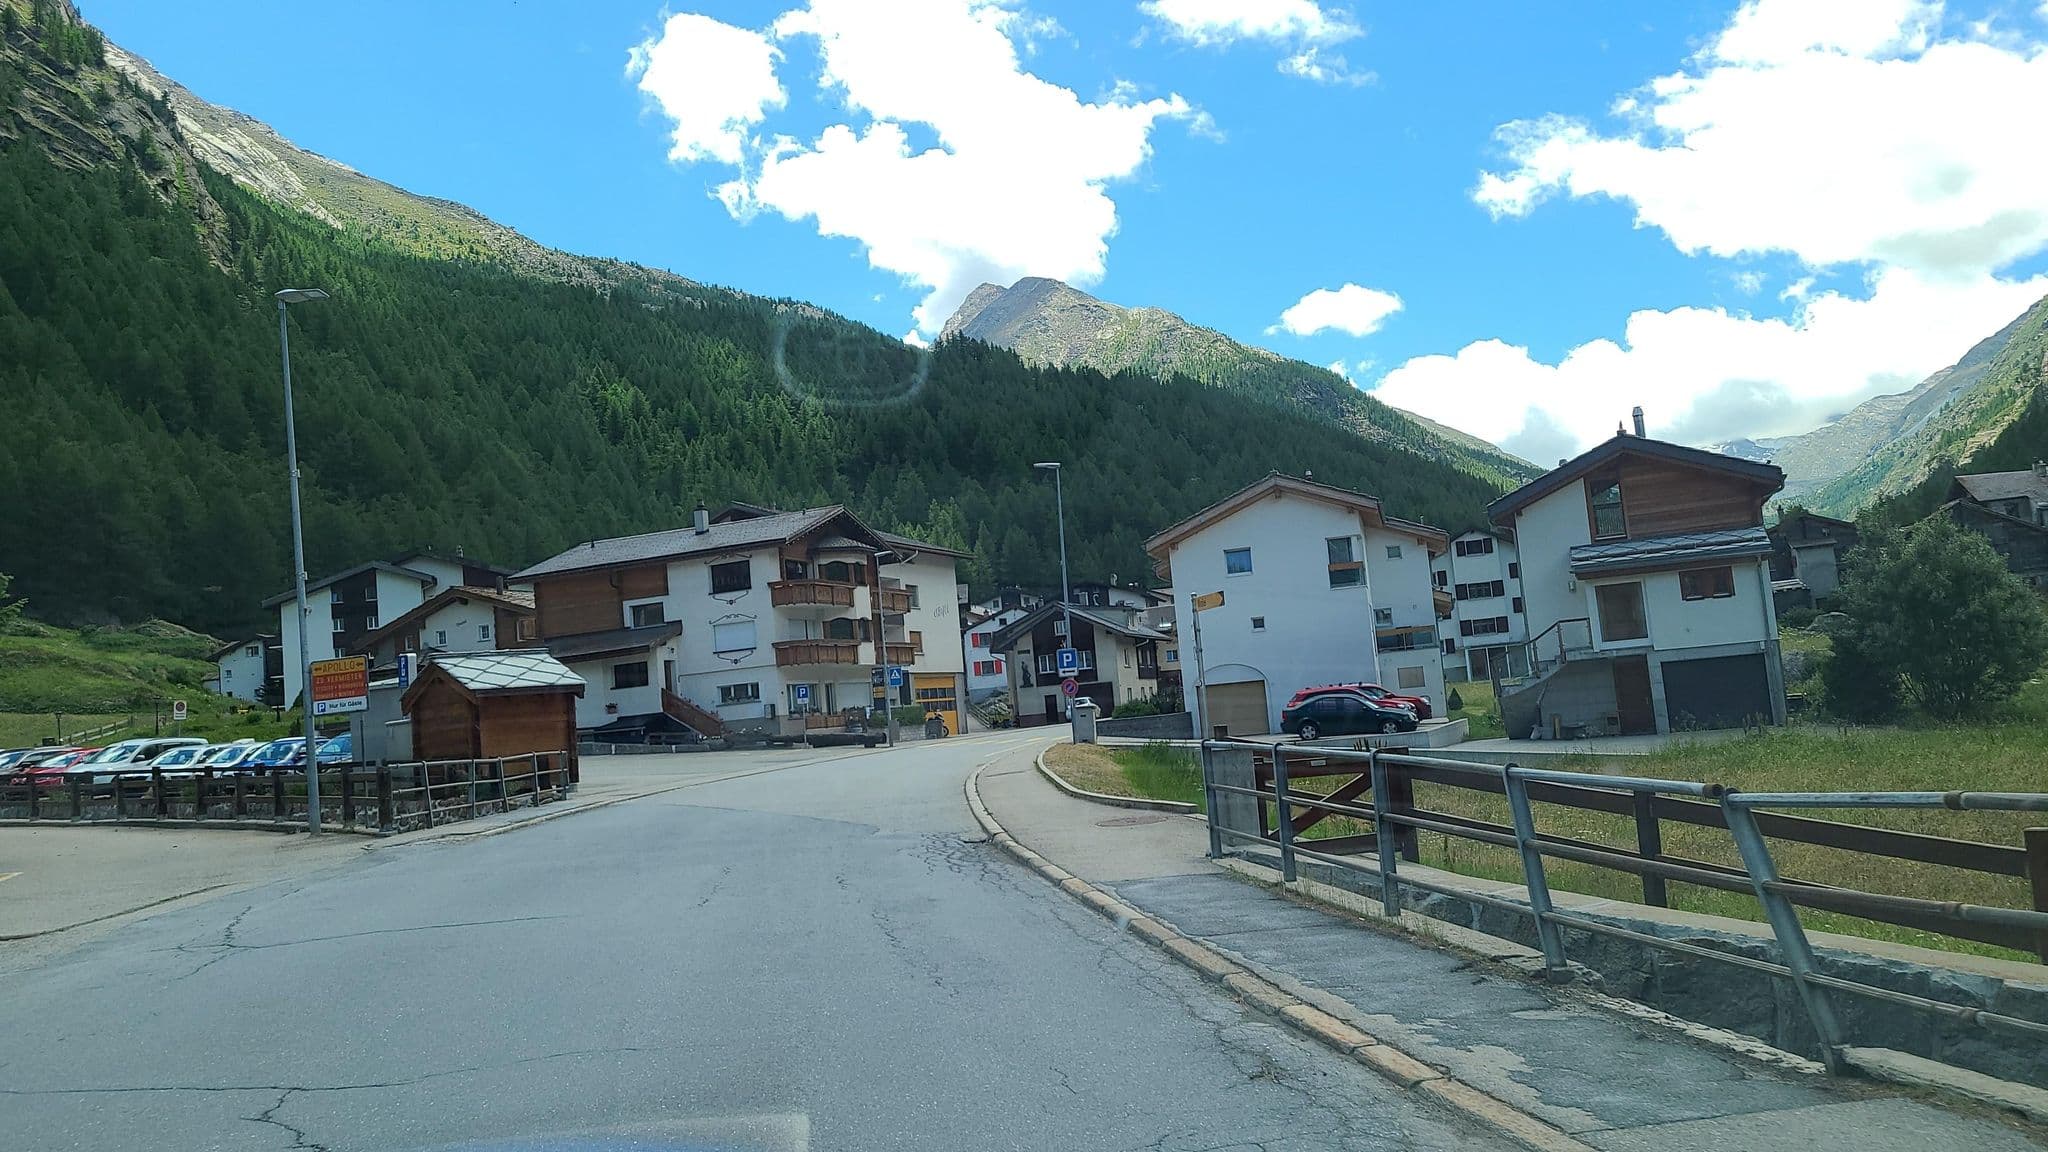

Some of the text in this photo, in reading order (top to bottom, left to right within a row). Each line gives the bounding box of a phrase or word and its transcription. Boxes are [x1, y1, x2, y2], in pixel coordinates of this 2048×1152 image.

[1063, 653, 1072, 666] P
[322, 660, 355, 673] APOLLO
[800, 688, 806, 697] P
[319, 703, 325, 712] P
